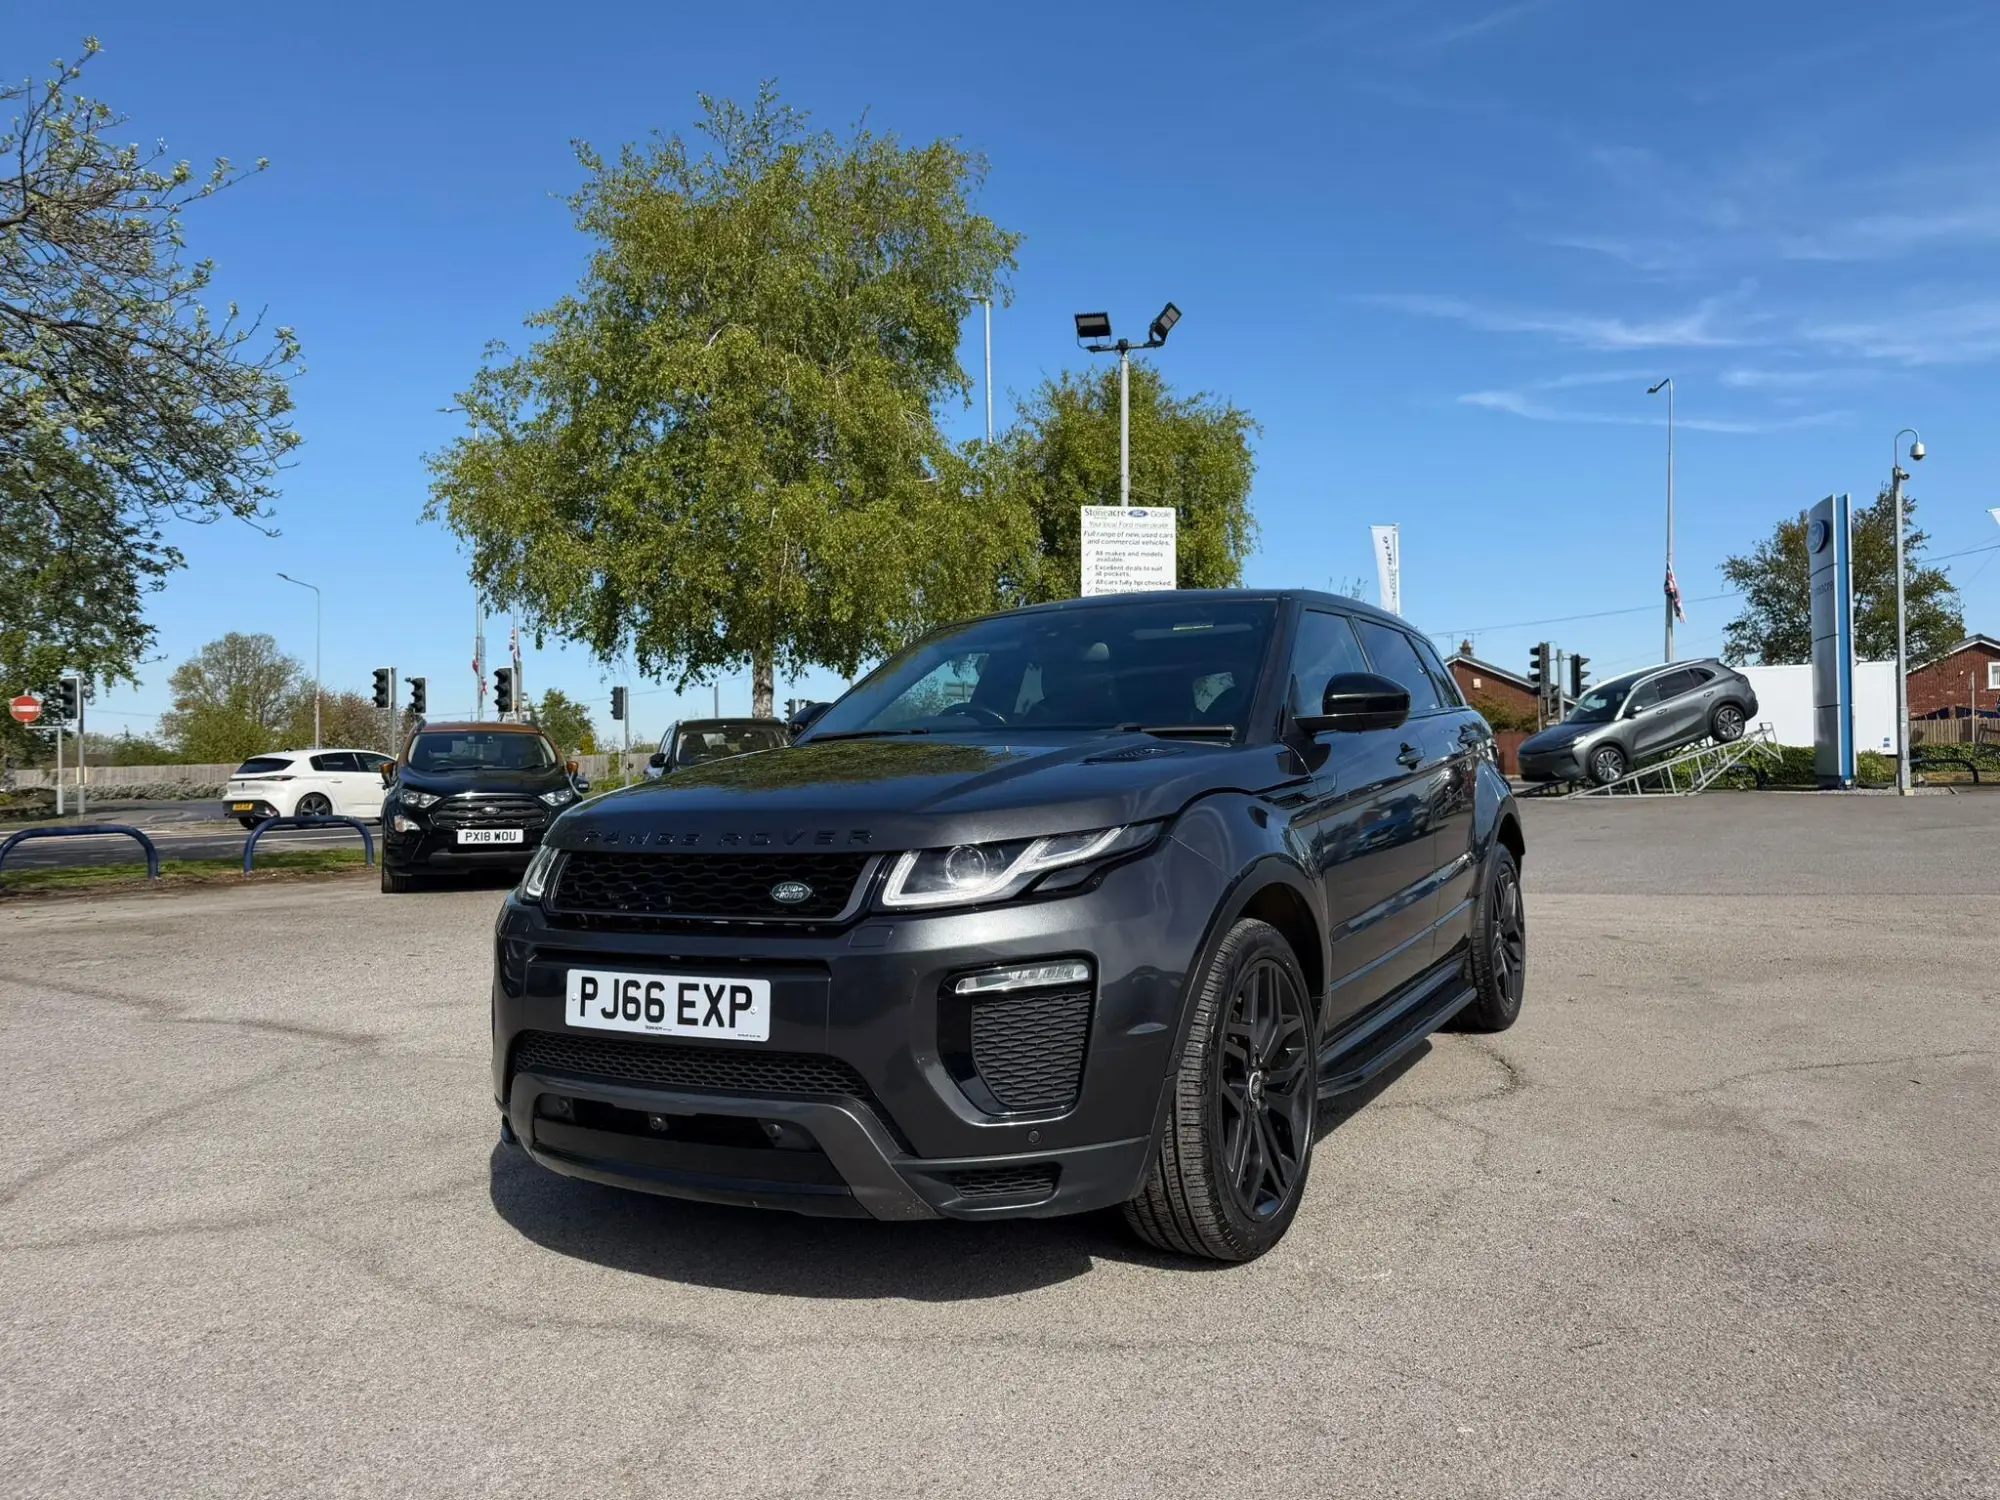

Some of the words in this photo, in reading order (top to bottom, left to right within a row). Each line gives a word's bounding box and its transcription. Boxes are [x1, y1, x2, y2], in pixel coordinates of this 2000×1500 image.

[465, 831, 491, 842] PX18
[494, 831, 517, 841] WOU
[580, 829, 702, 847] RANGE
[717, 829, 873, 847] ROVER
[779, 891, 804, 899] ROVER
[580, 976, 666, 1024] PJ66
[677, 982, 754, 1029] EXP
